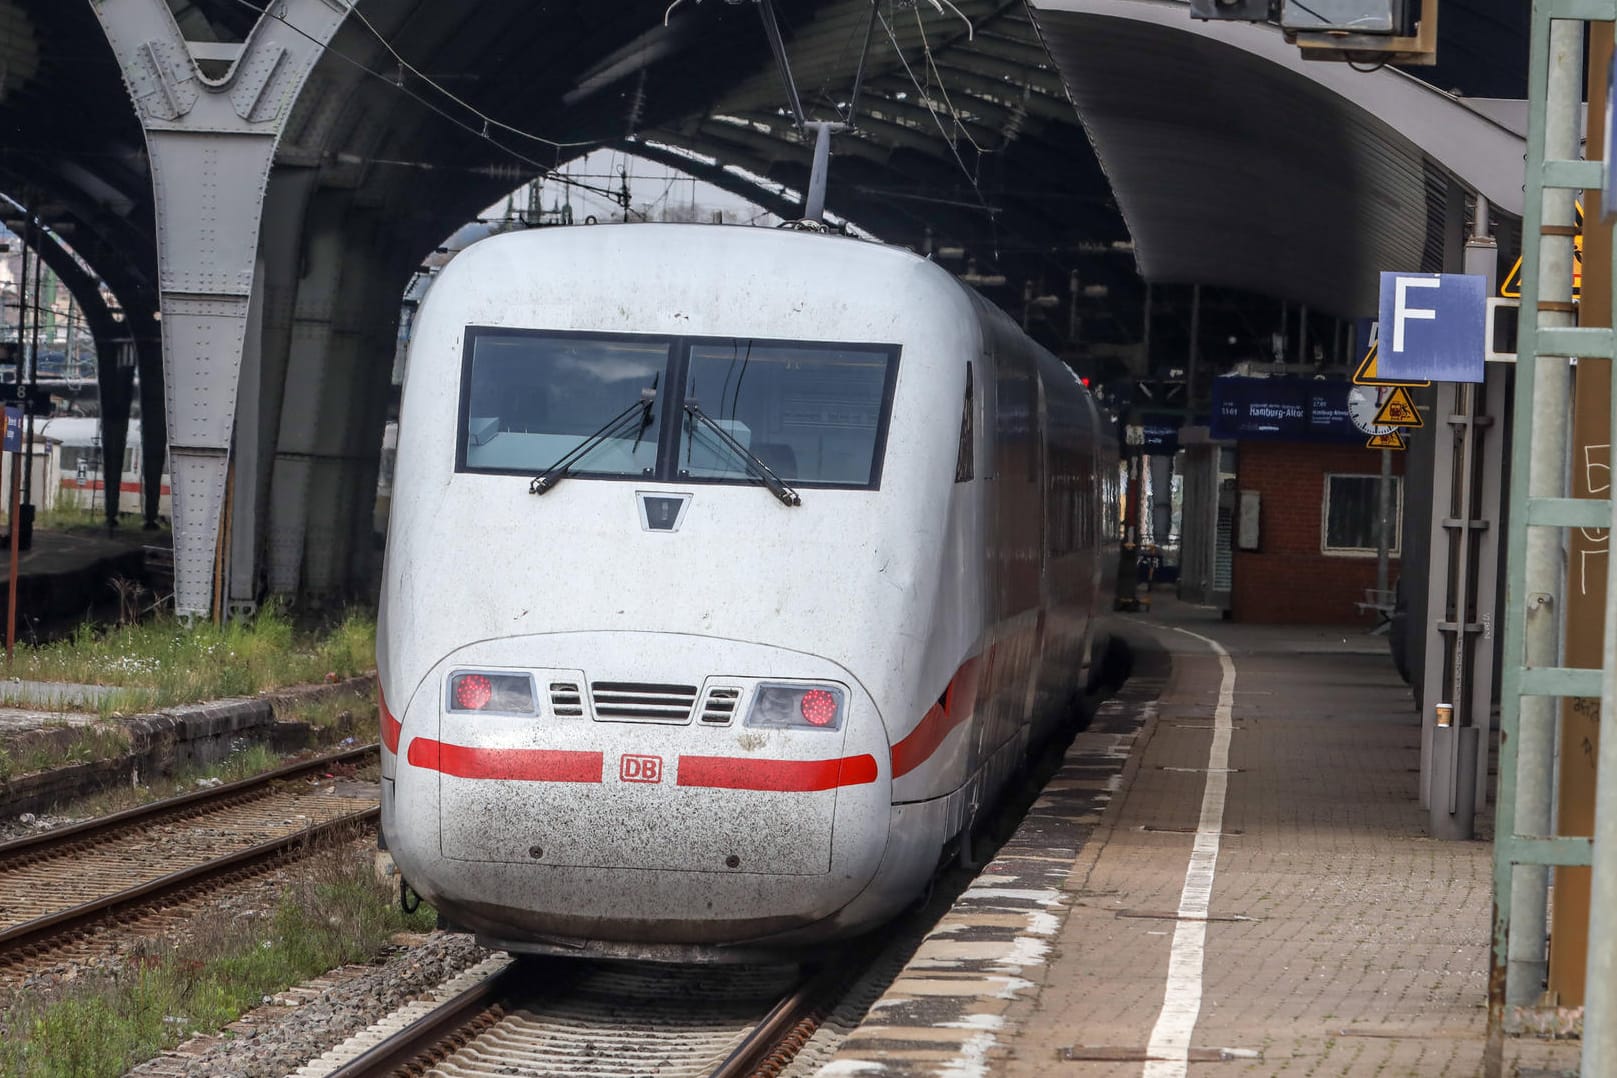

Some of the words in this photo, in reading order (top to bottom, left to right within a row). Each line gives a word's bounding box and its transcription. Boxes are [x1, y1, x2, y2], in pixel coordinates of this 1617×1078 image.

[1393, 277, 1440, 352] F
[17, 385, 26, 398] 8
[625, 759, 656, 778] DB
